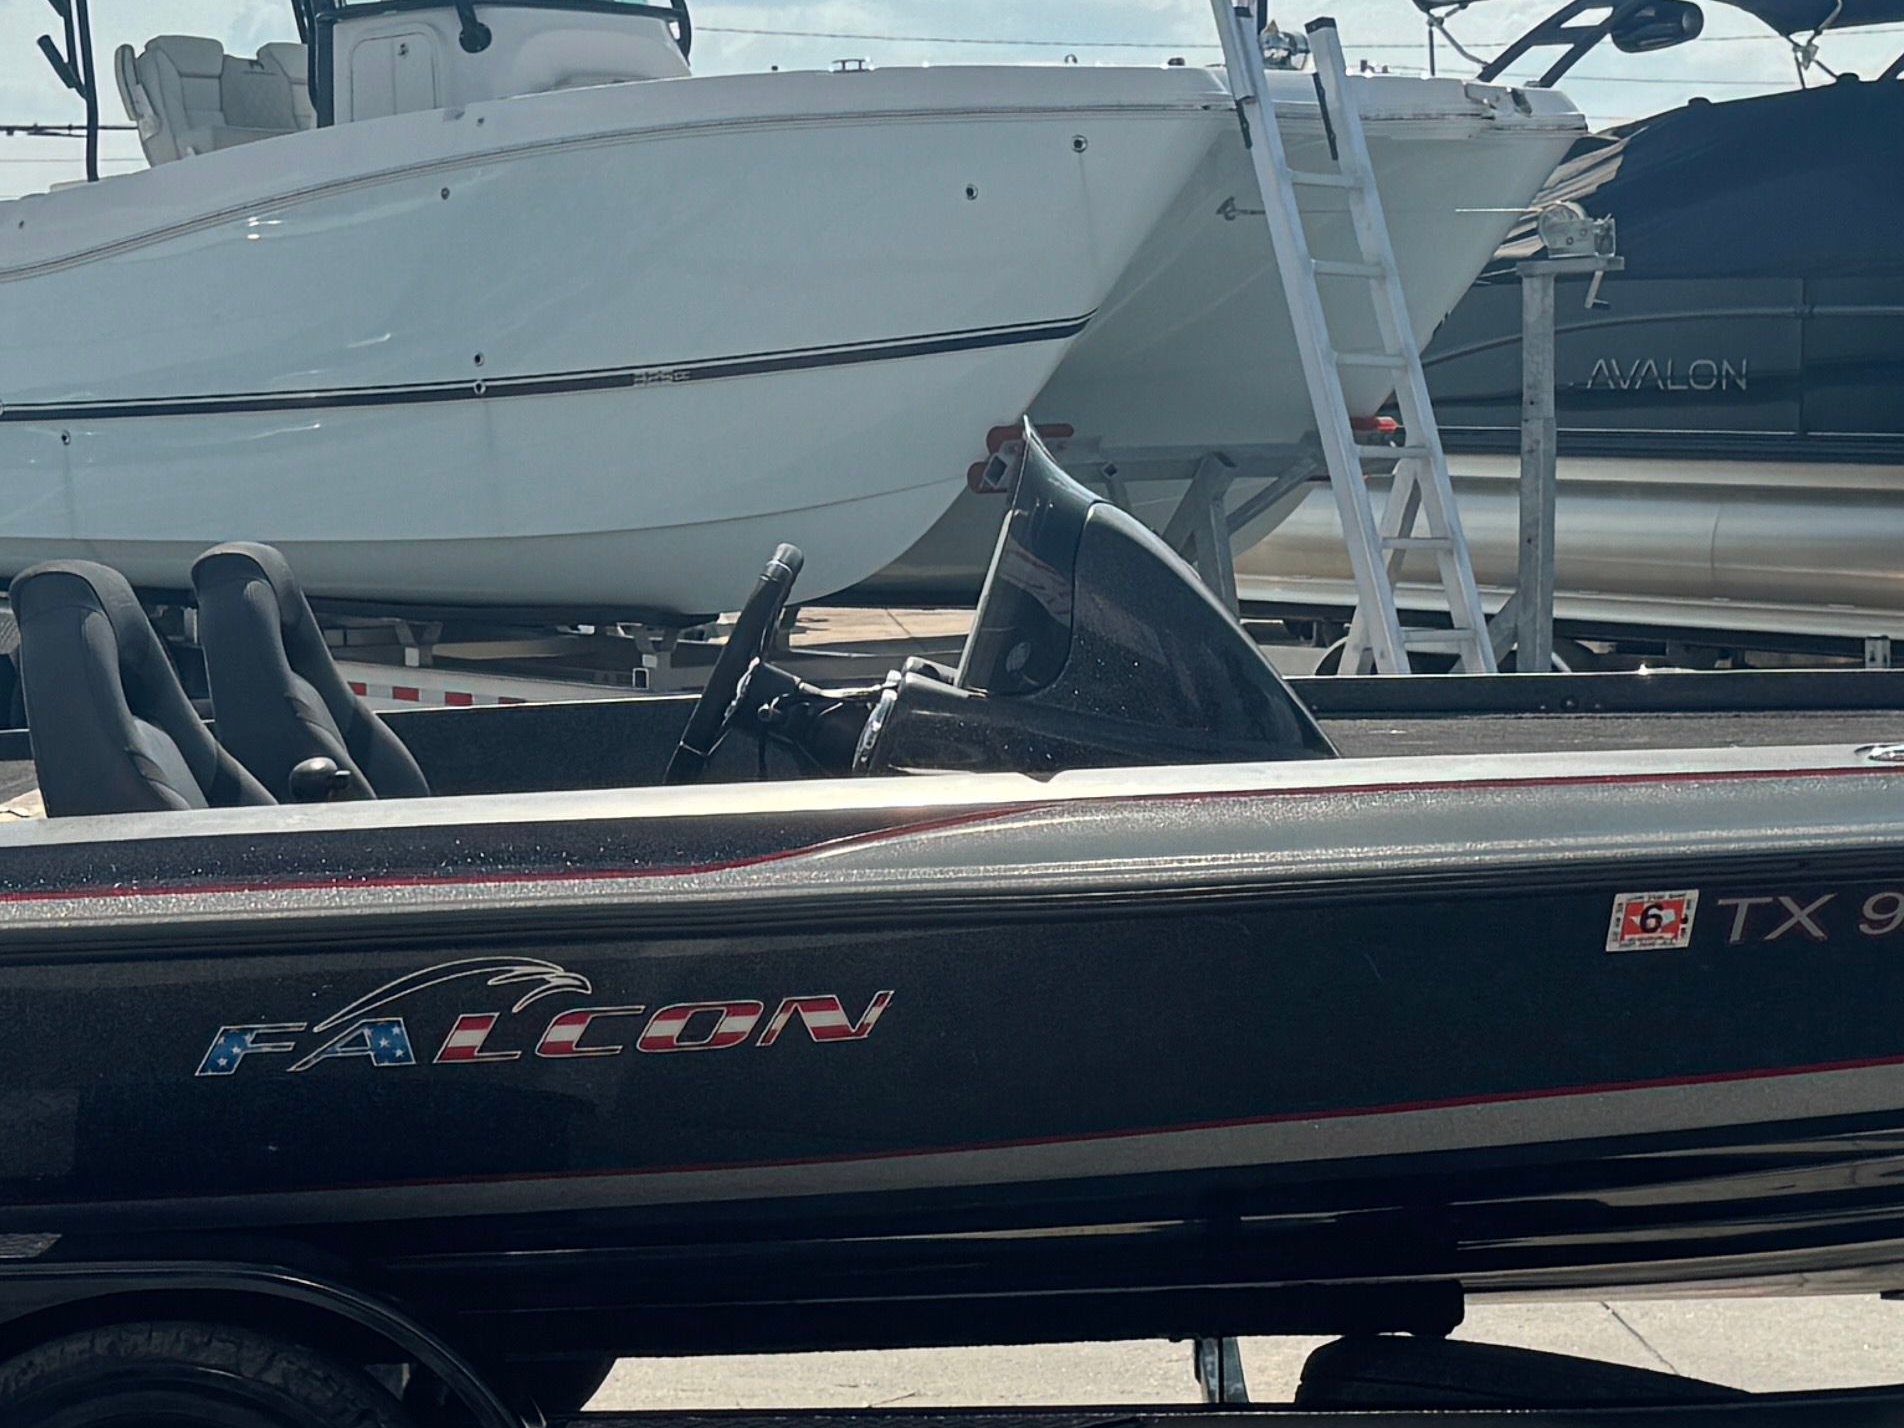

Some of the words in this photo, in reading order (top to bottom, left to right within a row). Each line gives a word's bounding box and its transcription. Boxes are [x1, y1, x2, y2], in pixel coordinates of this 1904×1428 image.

[1586, 358, 1747, 391] AVALON
[1639, 903, 1664, 934] 6
[1716, 892, 1838, 944] TX
[195, 988, 895, 1076] FALCON
